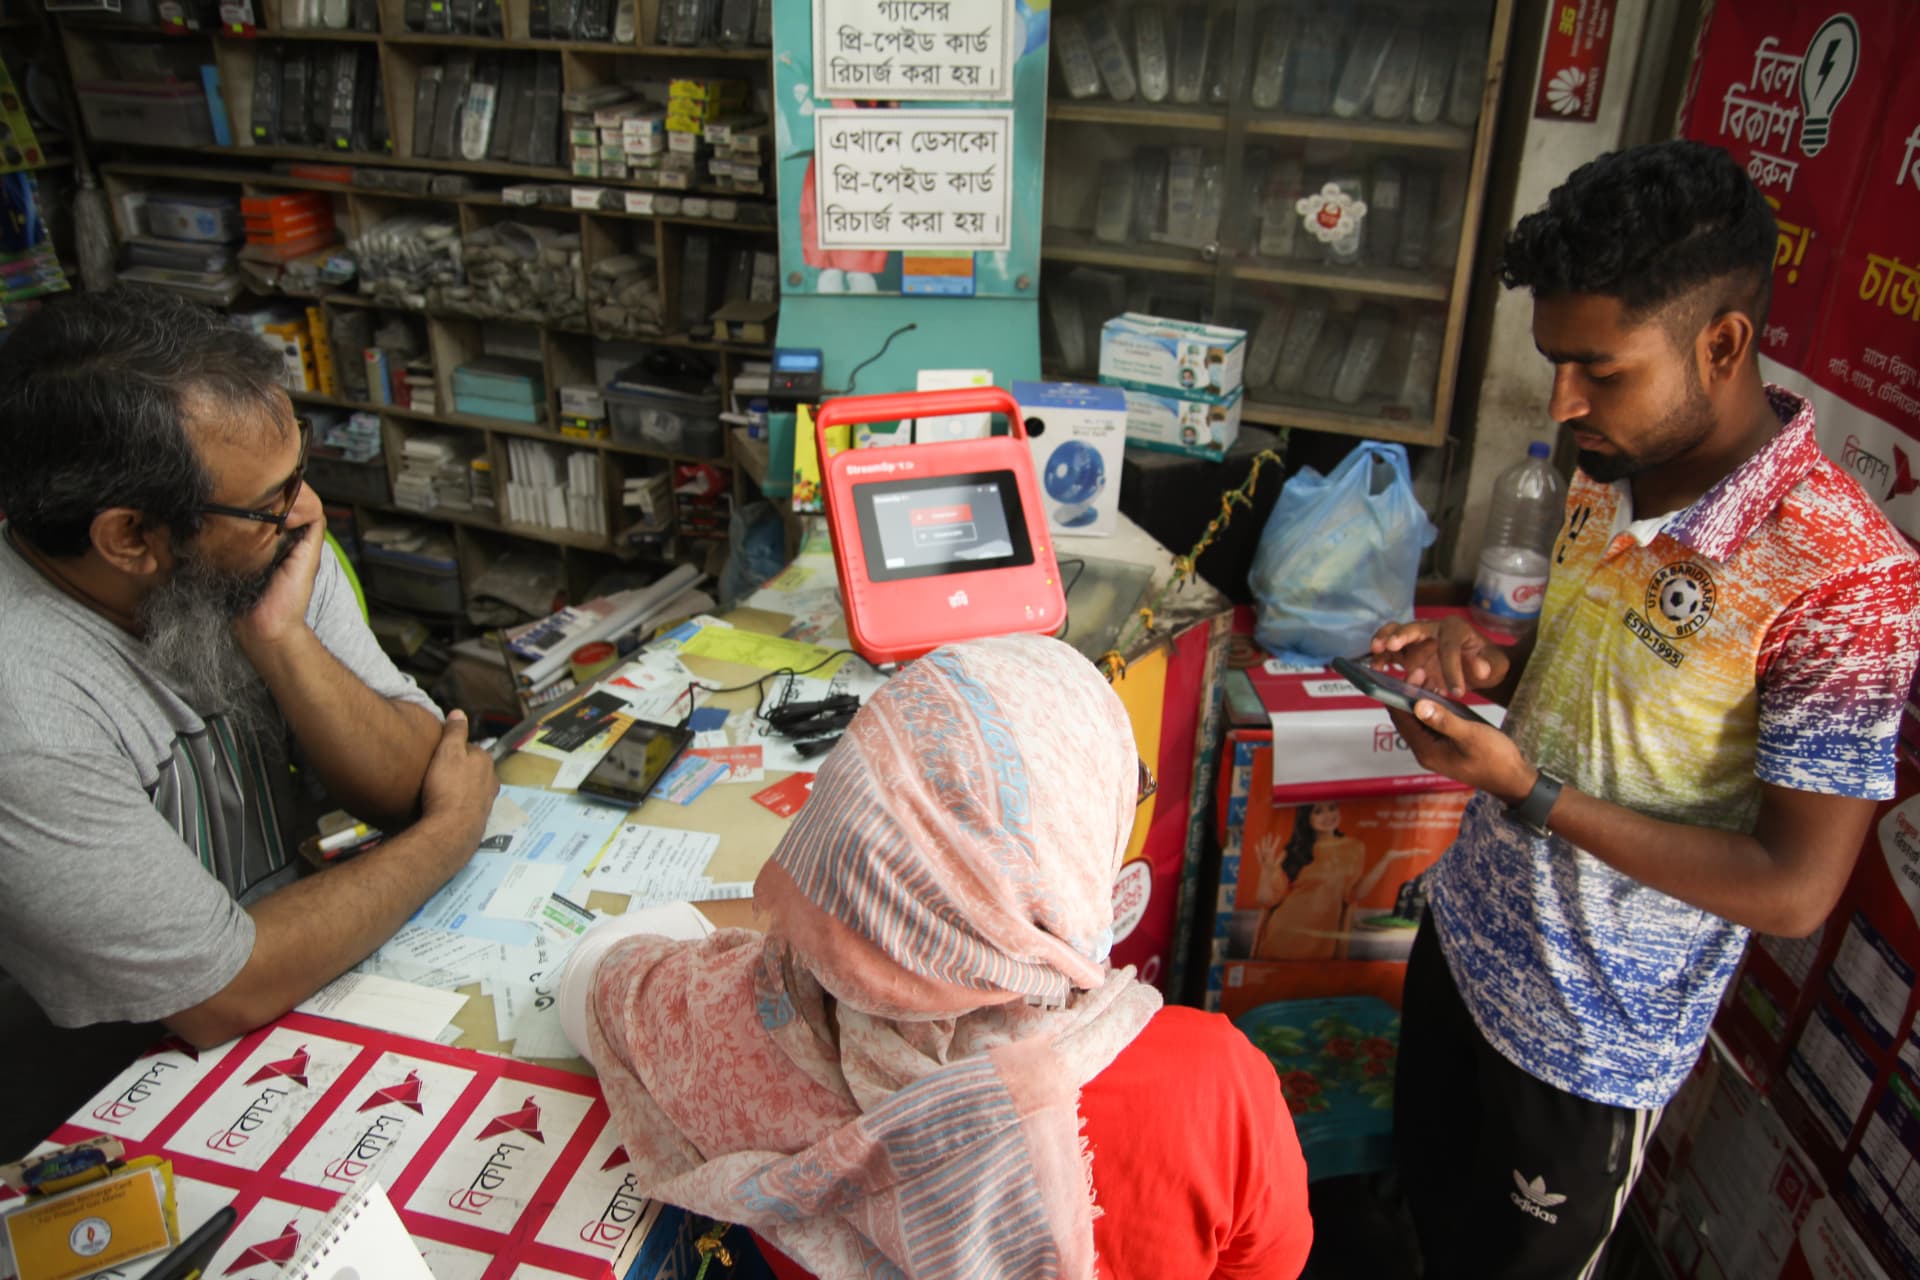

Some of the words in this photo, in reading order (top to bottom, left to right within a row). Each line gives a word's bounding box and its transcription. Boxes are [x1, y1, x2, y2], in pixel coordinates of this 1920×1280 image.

[838, 24, 936, 53] প্রি-পেইড
[945, 27, 992, 53] কার্ড
[829, 56, 895, 85] রিচার্জ
[901, 65, 941, 85] করা
[1750, 37, 1805, 98] বিল
[1719, 83, 1799, 153] বিকাশ
[829, 129, 902, 152] এখানে
[911, 130, 999, 153] ডেসকো
[833, 164, 937, 193] প্রি-পেইড
[946, 164, 996, 193] কার্ড
[1747, 150, 1799, 192] করুন
[826, 203, 893, 234] রিচার্জ
[900, 211, 944, 234] করা
[1839, 434, 1890, 482] বিকাশ
[1647, 570, 1668, 609] UTTAR
[1669, 564, 1713, 612] BARIDHARA
[1624, 611, 1681, 665] ESTD-1995
[1675, 614, 1705, 636] CLUB
[92, 1061, 178, 1125] বিকাশ
[206, 1088, 288, 1154] বিকাশ
[323, 1114, 404, 1185] বিকাশ
[448, 1142, 525, 1216] বিকাশ
[1509, 1191, 1559, 1225] adidas
